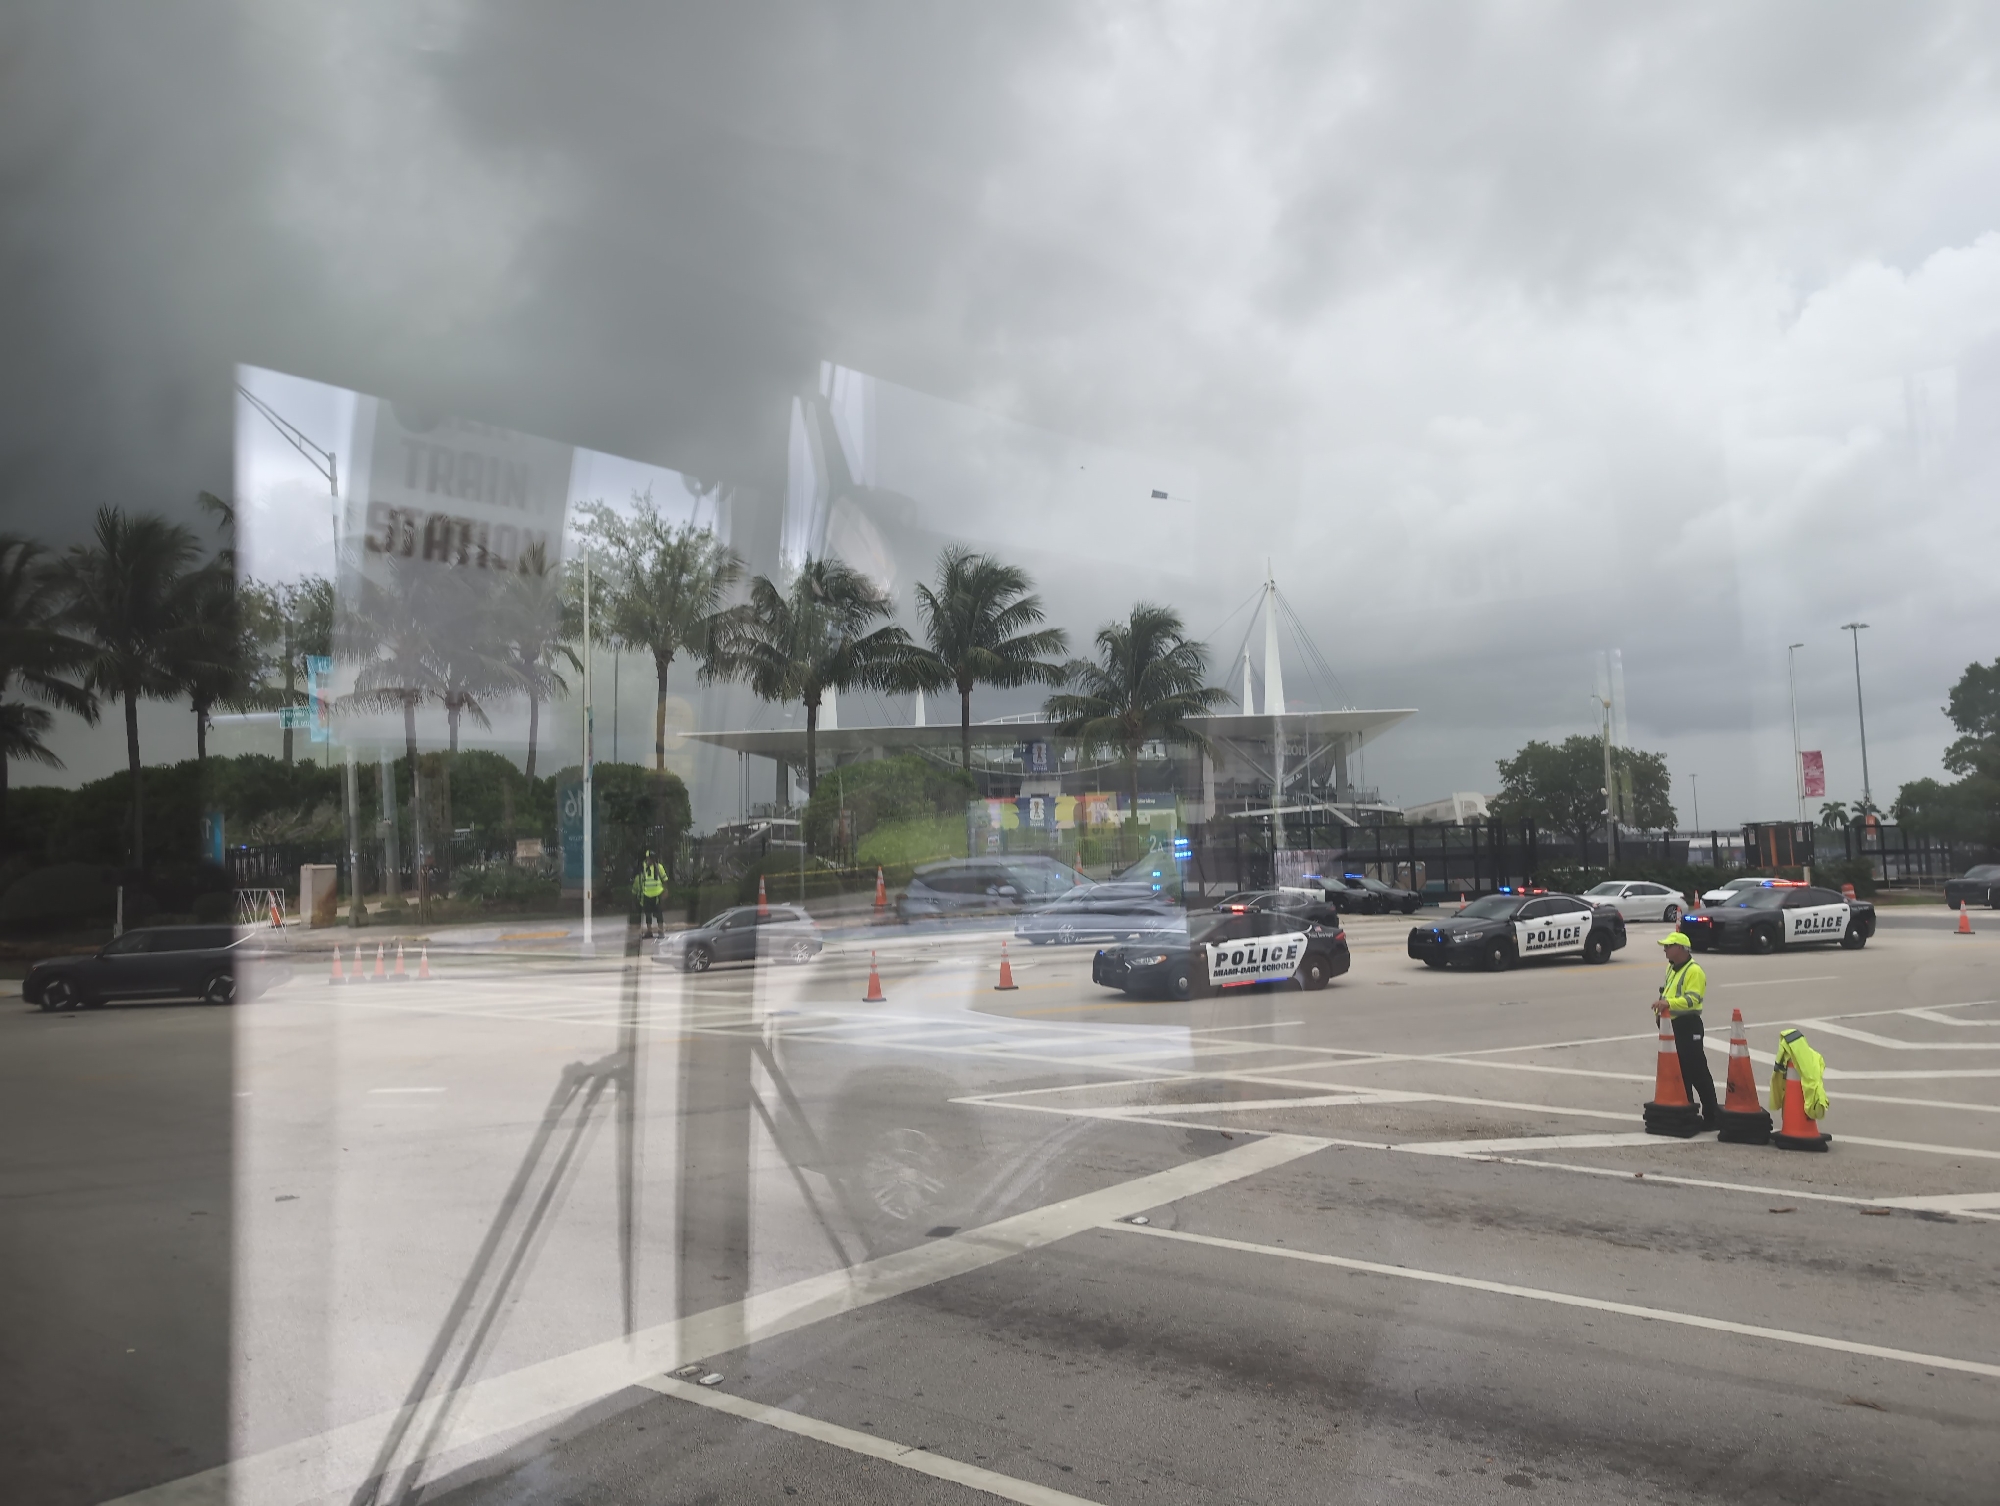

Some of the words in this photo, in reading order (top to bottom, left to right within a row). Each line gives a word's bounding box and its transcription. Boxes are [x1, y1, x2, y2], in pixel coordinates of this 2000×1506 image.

[399, 436, 530, 510] TRAIN
[1261, 742, 1308, 757] vezon
[1795, 916, 1842, 929] POLICE
[1527, 926, 1580, 944] POLICE
[1215, 945, 1298, 967] POLICE
[1213, 964, 1261, 977] MIAMI-DADE
[1261, 961, 1295, 972] SCHOOLS
